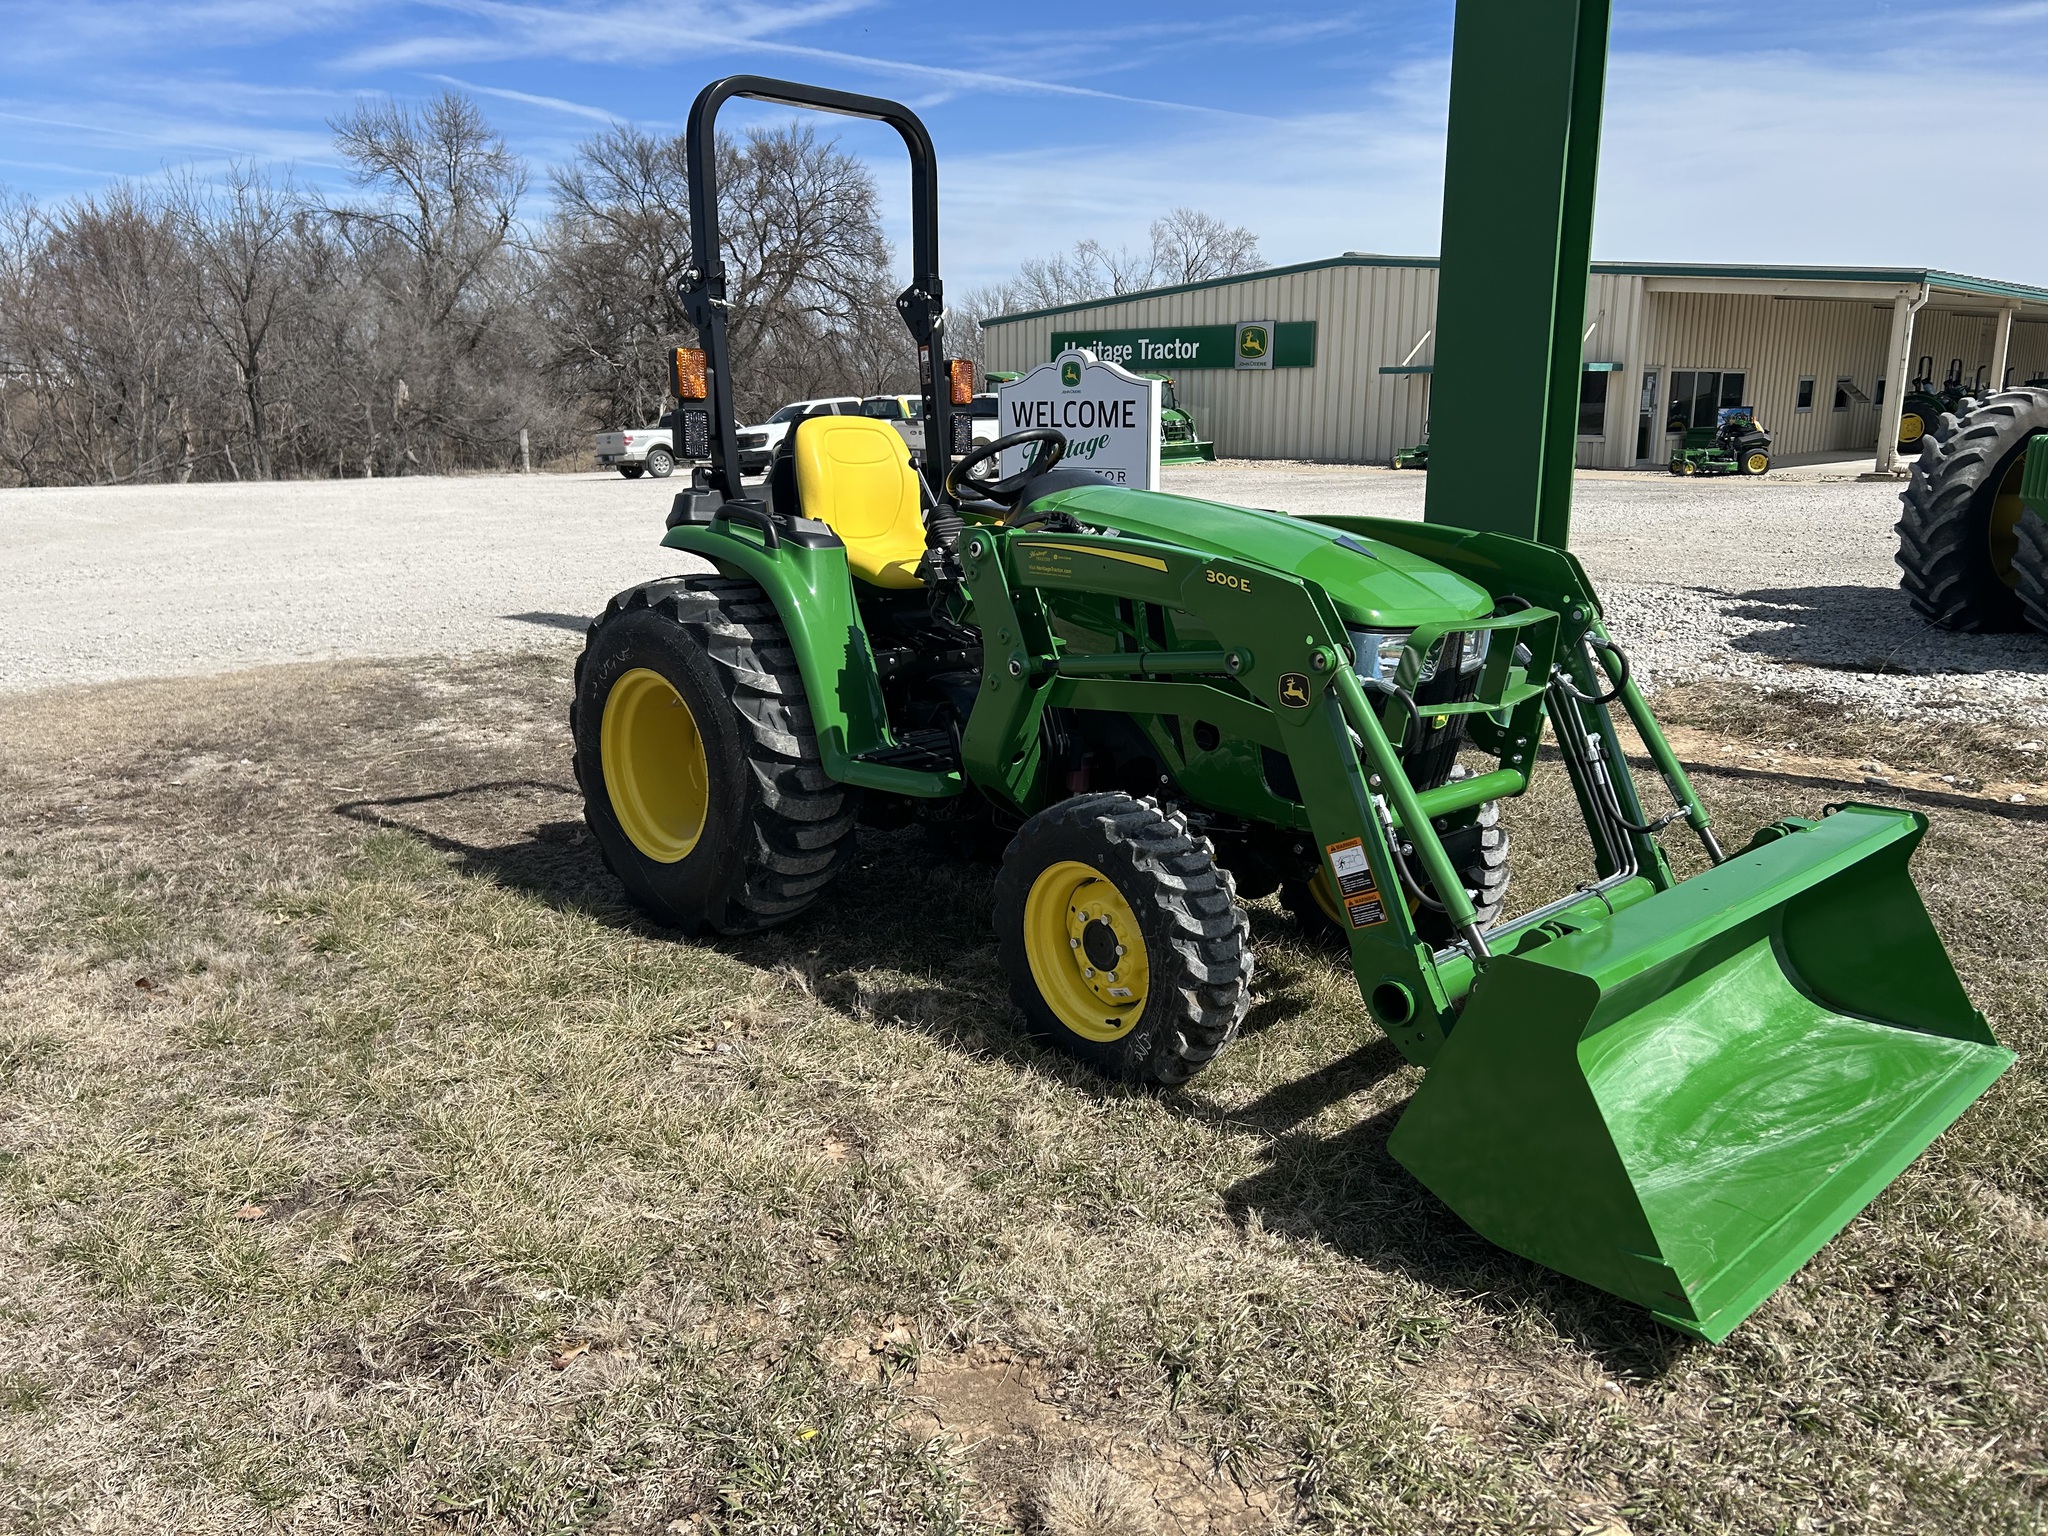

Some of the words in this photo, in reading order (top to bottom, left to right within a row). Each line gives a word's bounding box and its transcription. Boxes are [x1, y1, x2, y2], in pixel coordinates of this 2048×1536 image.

[1064, 340, 1133, 365] itage
[1137, 338, 1200, 360] Tractor
[1011, 400, 1136, 428] WELCOME
[1206, 569, 1251, 593] 300E
